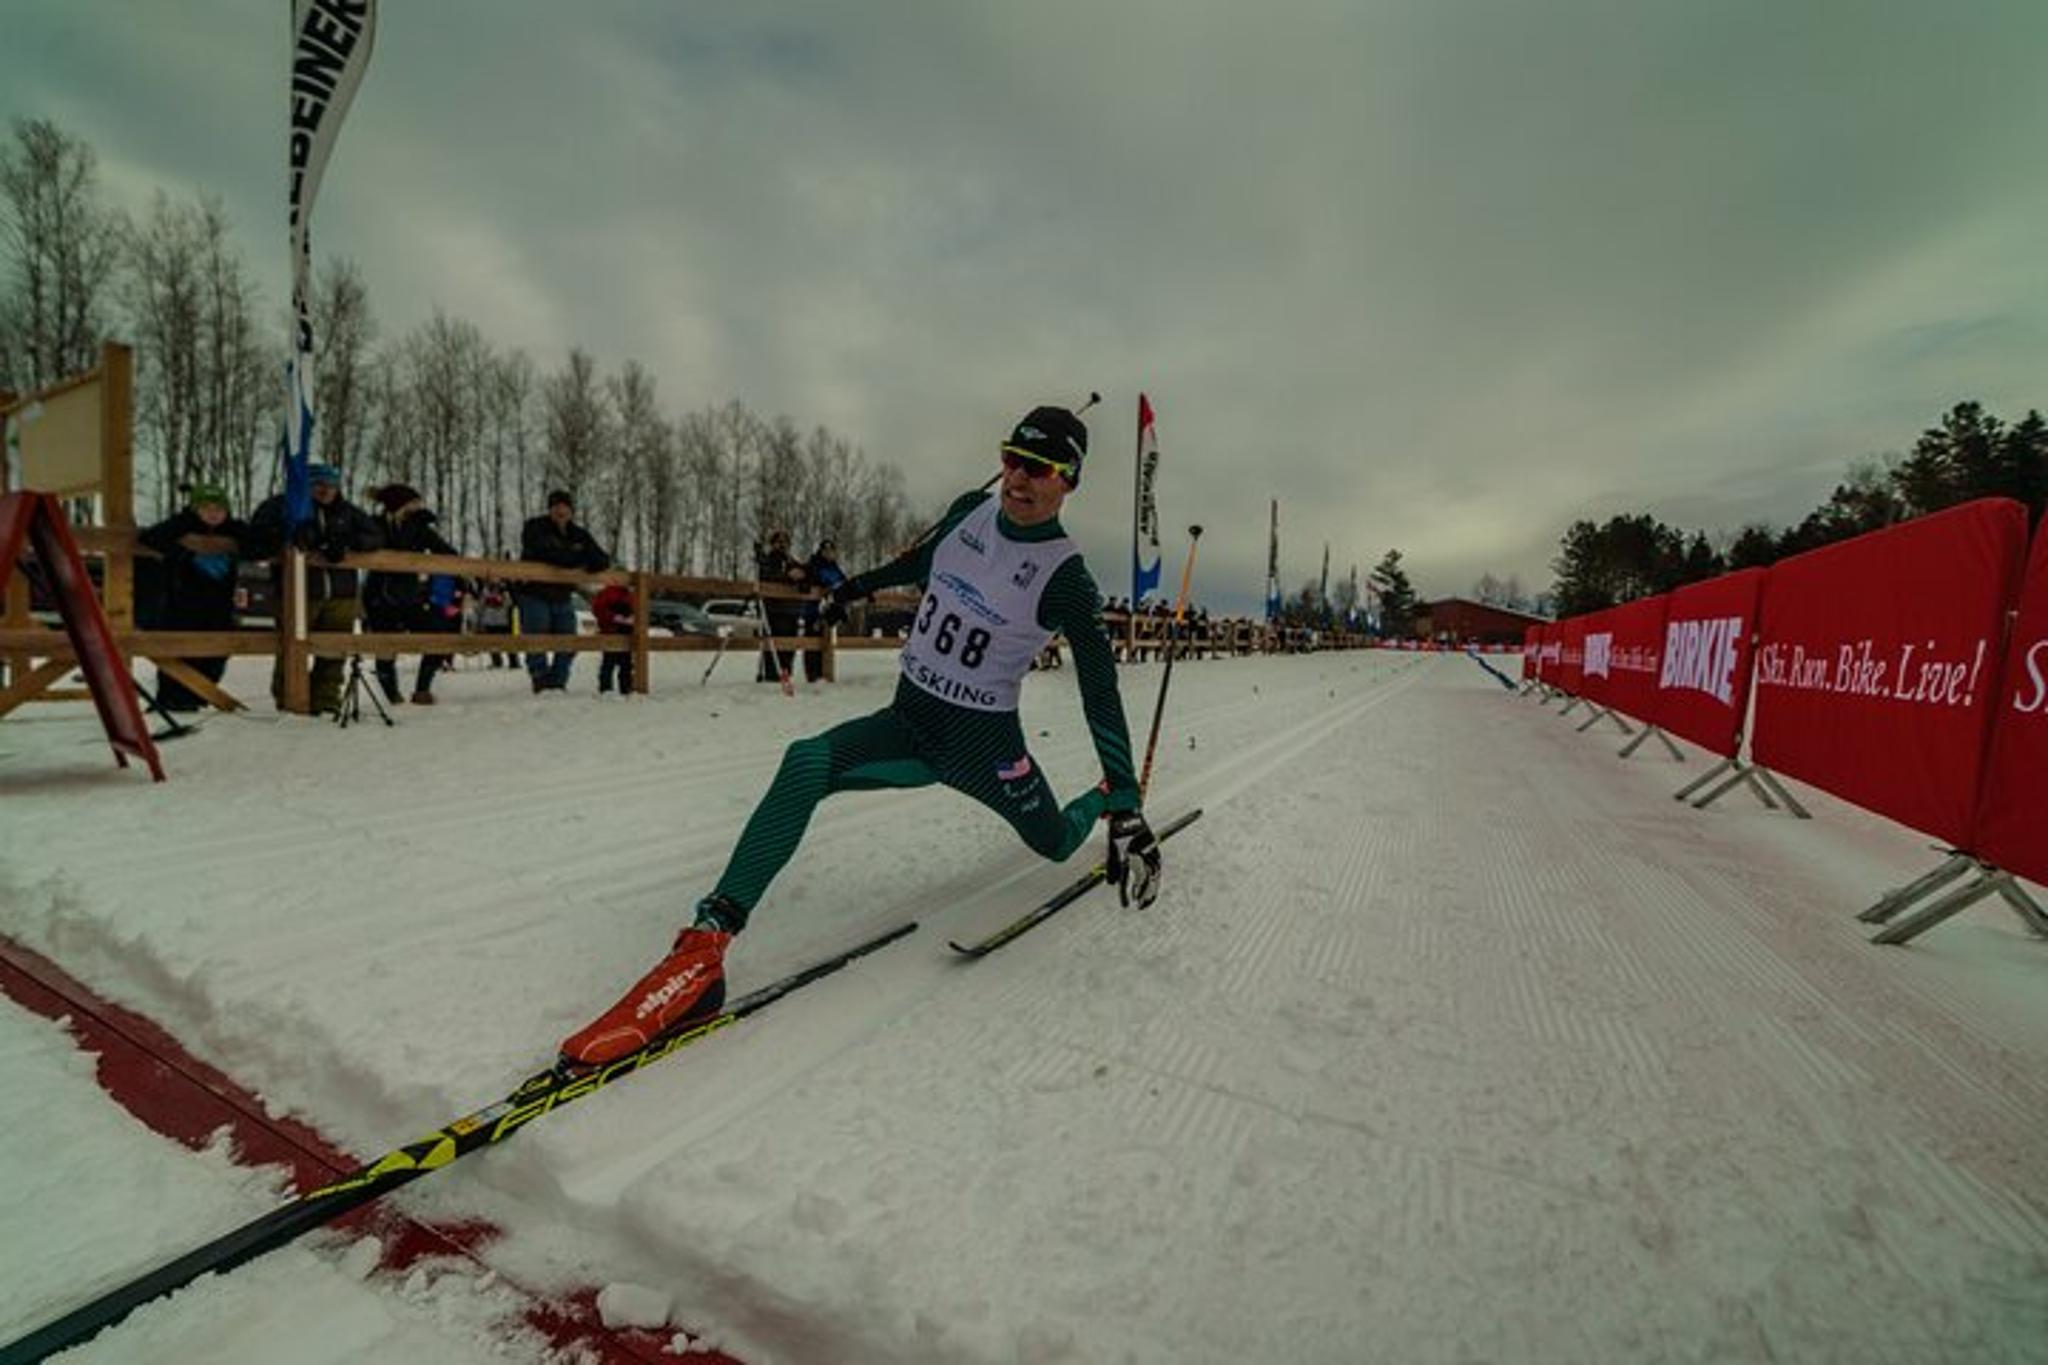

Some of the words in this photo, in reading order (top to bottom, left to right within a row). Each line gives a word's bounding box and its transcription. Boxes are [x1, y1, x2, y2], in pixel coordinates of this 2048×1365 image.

[918, 594, 991, 670] 368
[1660, 616, 1743, 708] BIRKIE
[916, 666, 998, 706] SKIING
[1760, 642, 1788, 686] Ski.
[1789, 645, 1831, 691] Run.
[1834, 639, 1890, 698] Bike.
[1894, 639, 1987, 707] Live!
[2013, 639, 2048, 713] S
